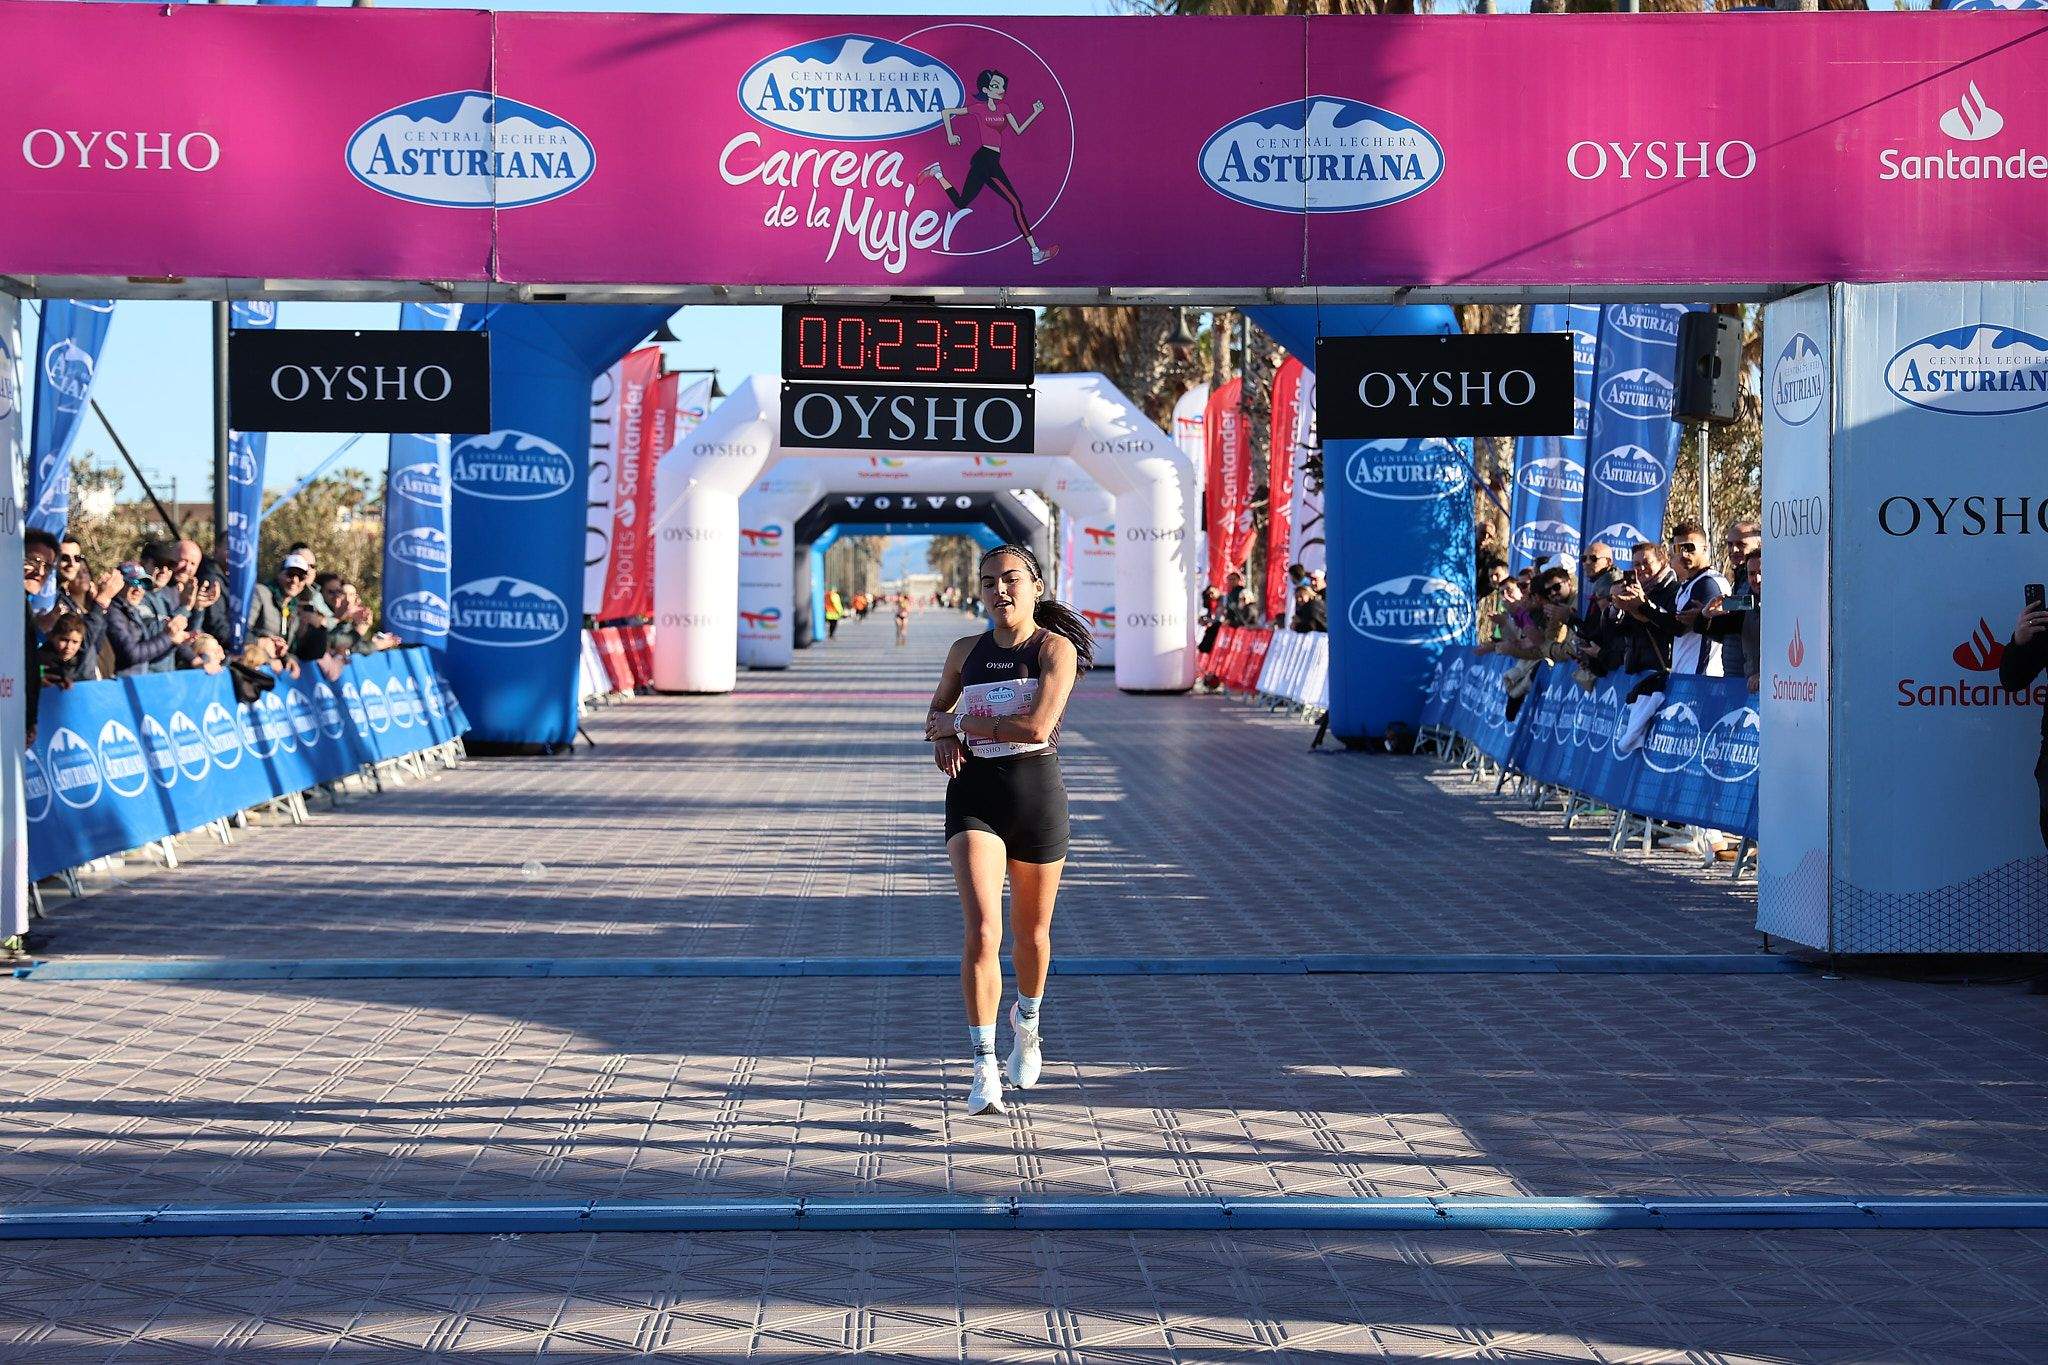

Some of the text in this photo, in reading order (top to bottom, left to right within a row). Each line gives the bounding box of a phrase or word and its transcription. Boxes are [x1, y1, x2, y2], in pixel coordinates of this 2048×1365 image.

[756, 73, 946, 113] ASTURIANA
[791, 71, 941, 82] CENTRAL LECHERA
[22, 128, 221, 172] OYSHO
[366, 133, 577, 179] ASTURIANA
[404, 131, 568, 146] CENTRAL LECHERA
[1256, 136, 1417, 149] CENTRAL LECHERA
[718, 131, 904, 189] Carrera
[1217, 140, 1426, 184] ASTURIANA
[1566, 140, 1757, 180] OYSHO
[764, 183, 974, 275] de la Mujer
[800, 317, 1017, 372] 00:23:39
[1929, 357, 1990, 365] CENTRAL
[271, 364, 452, 402] OYSHO
[1358, 369, 1536, 408] OYSHO
[1776, 371, 1822, 406] ASTURIANA
[793, 392, 1023, 444] OYSHO
[617, 380, 644, 497] Santander
[692, 443, 757, 457] OYSHO
[1091, 440, 1154, 454] OYSHO
[453, 455, 566, 486] ASTURIANA
[1600, 460, 1657, 486] ASTURIANA
[844, 495, 973, 510] VOLVO
[1770, 496, 1822, 539] OYSHO
[611, 529, 638, 601] Sports
[451, 601, 560, 632] ASTURIANA
[1772, 673, 1818, 703] Santander
